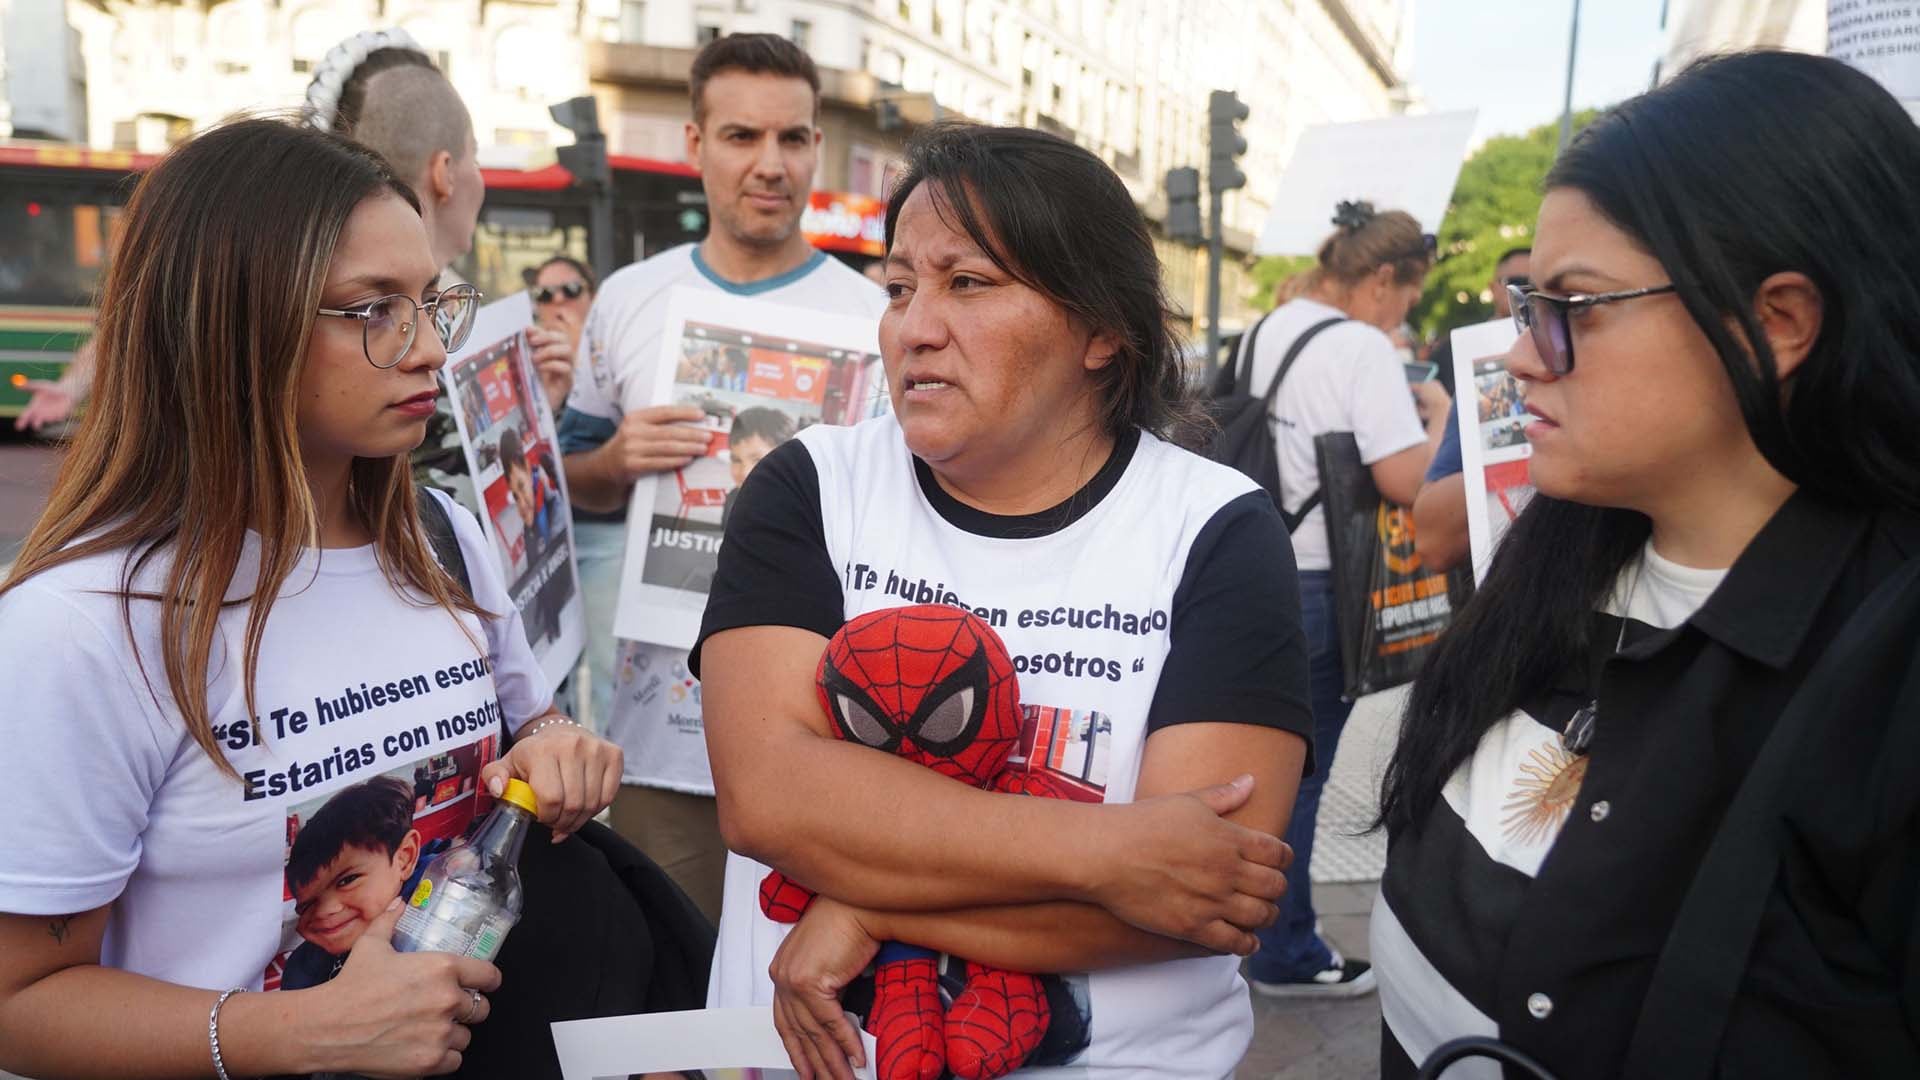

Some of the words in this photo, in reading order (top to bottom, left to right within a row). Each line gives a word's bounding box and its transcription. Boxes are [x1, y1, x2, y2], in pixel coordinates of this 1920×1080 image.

[854, 564, 878, 590] Te
[1017, 603, 1167, 635] escuchado
[270, 707, 308, 740] Te
[315, 674, 430, 726] hubiesen
[243, 742, 376, 802] Estarias
[383, 725, 430, 758] con
